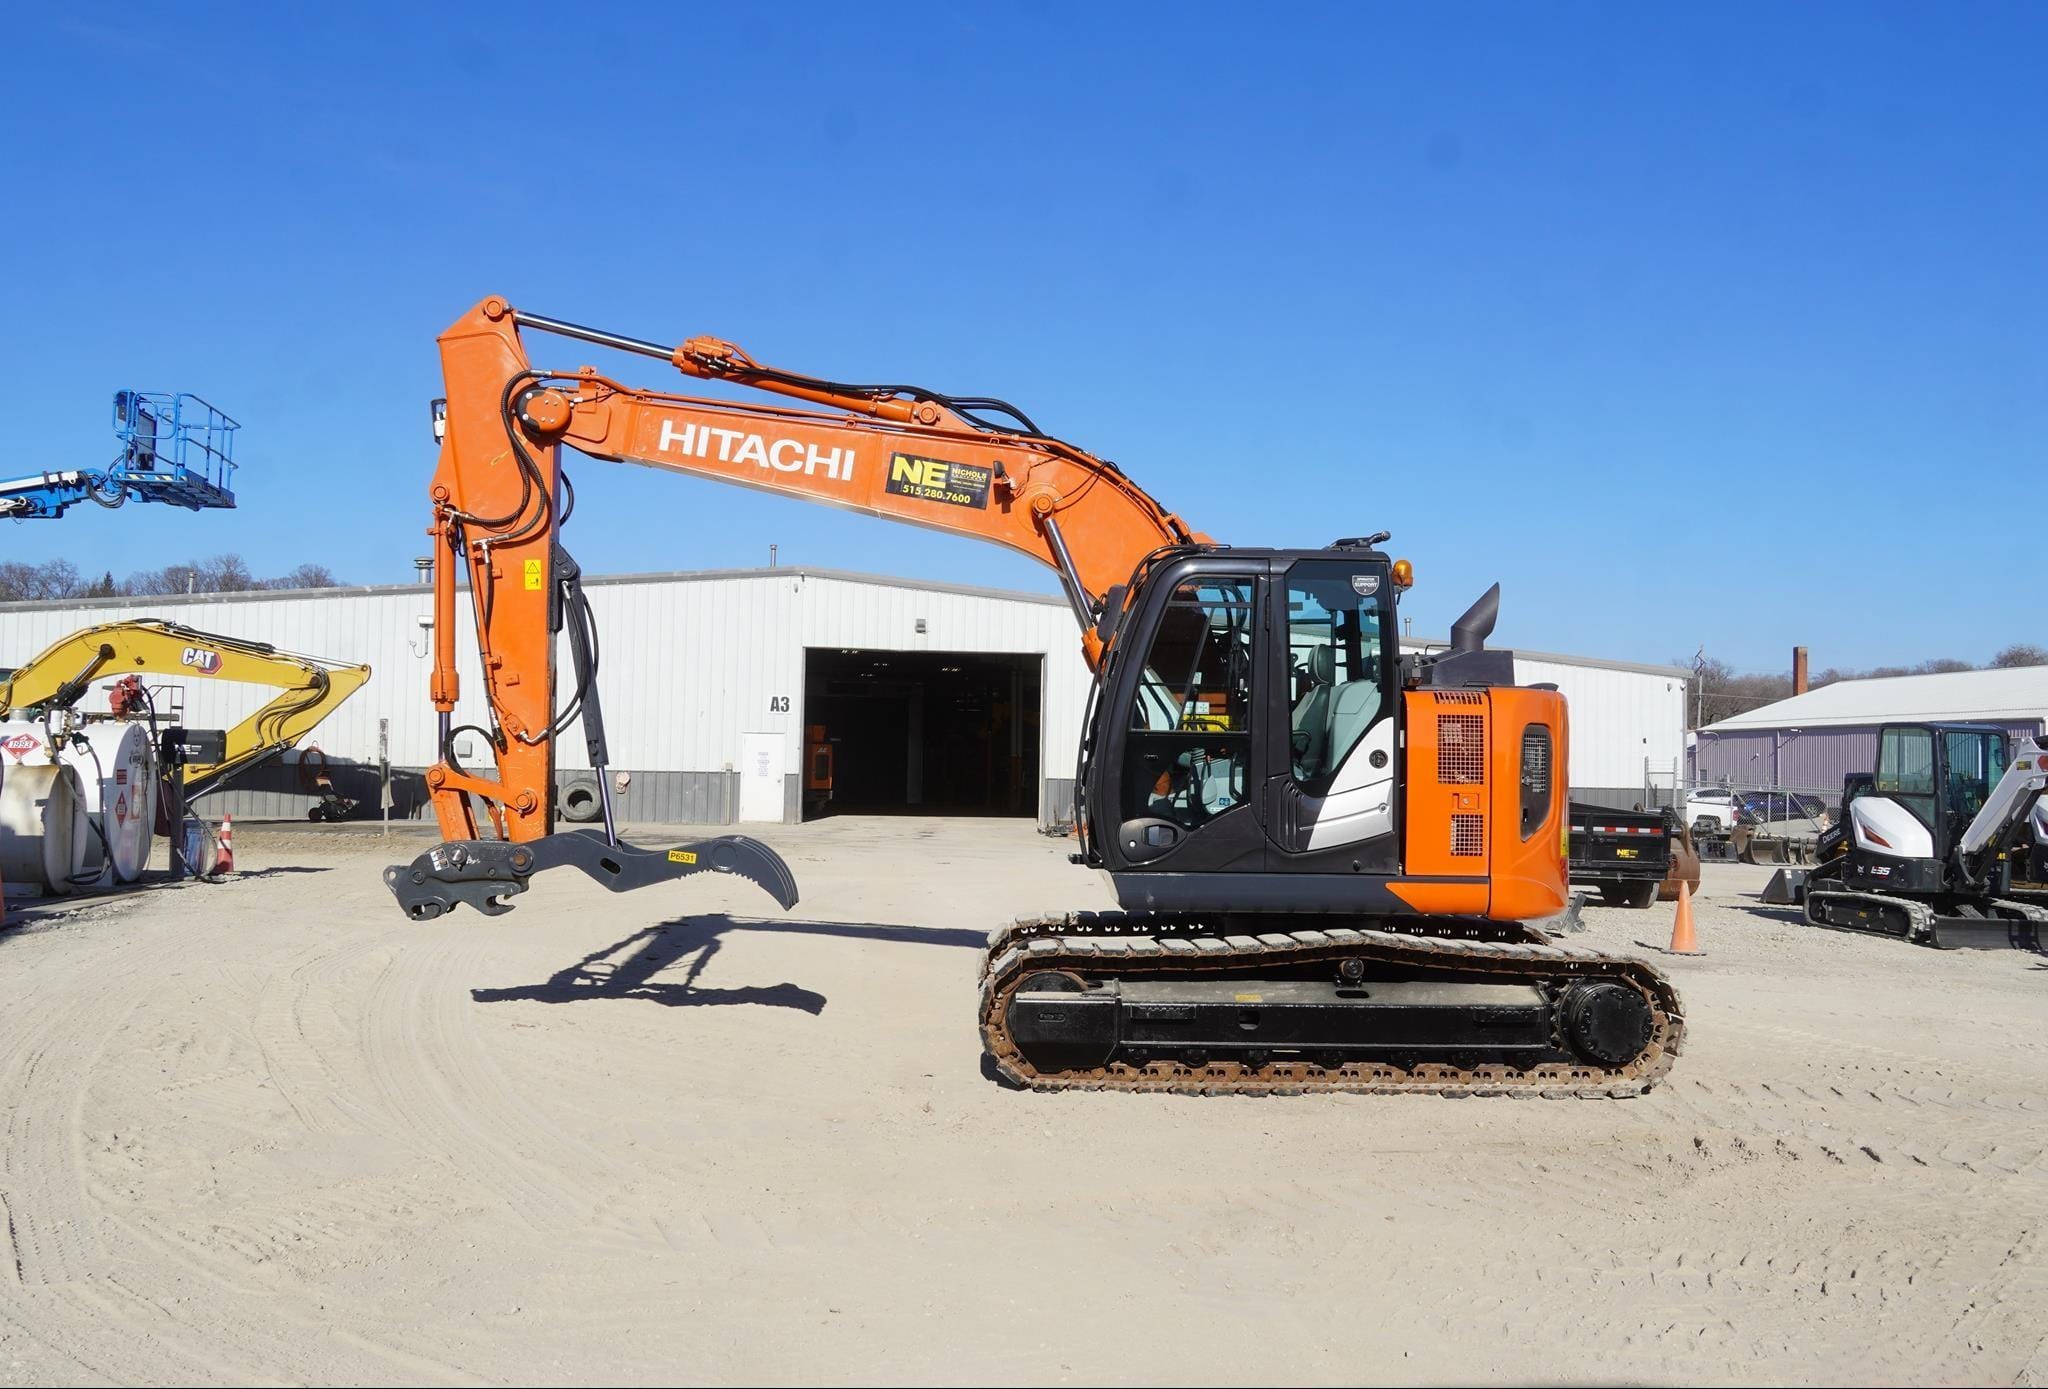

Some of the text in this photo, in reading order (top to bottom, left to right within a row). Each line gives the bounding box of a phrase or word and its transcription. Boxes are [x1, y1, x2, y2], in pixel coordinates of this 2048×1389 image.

[658, 420, 855, 481] HITACHI
[891, 456, 949, 489] NE
[952, 468, 987, 480] NICHOLS
[902, 485, 971, 504] 515.280.7600
[183, 647, 215, 669] CAT
[770, 696, 790, 712] A3
[1822, 828, 1841, 844] DEERE
[670, 852, 694, 861] P6531
[1616, 848, 1630, 856] NE
